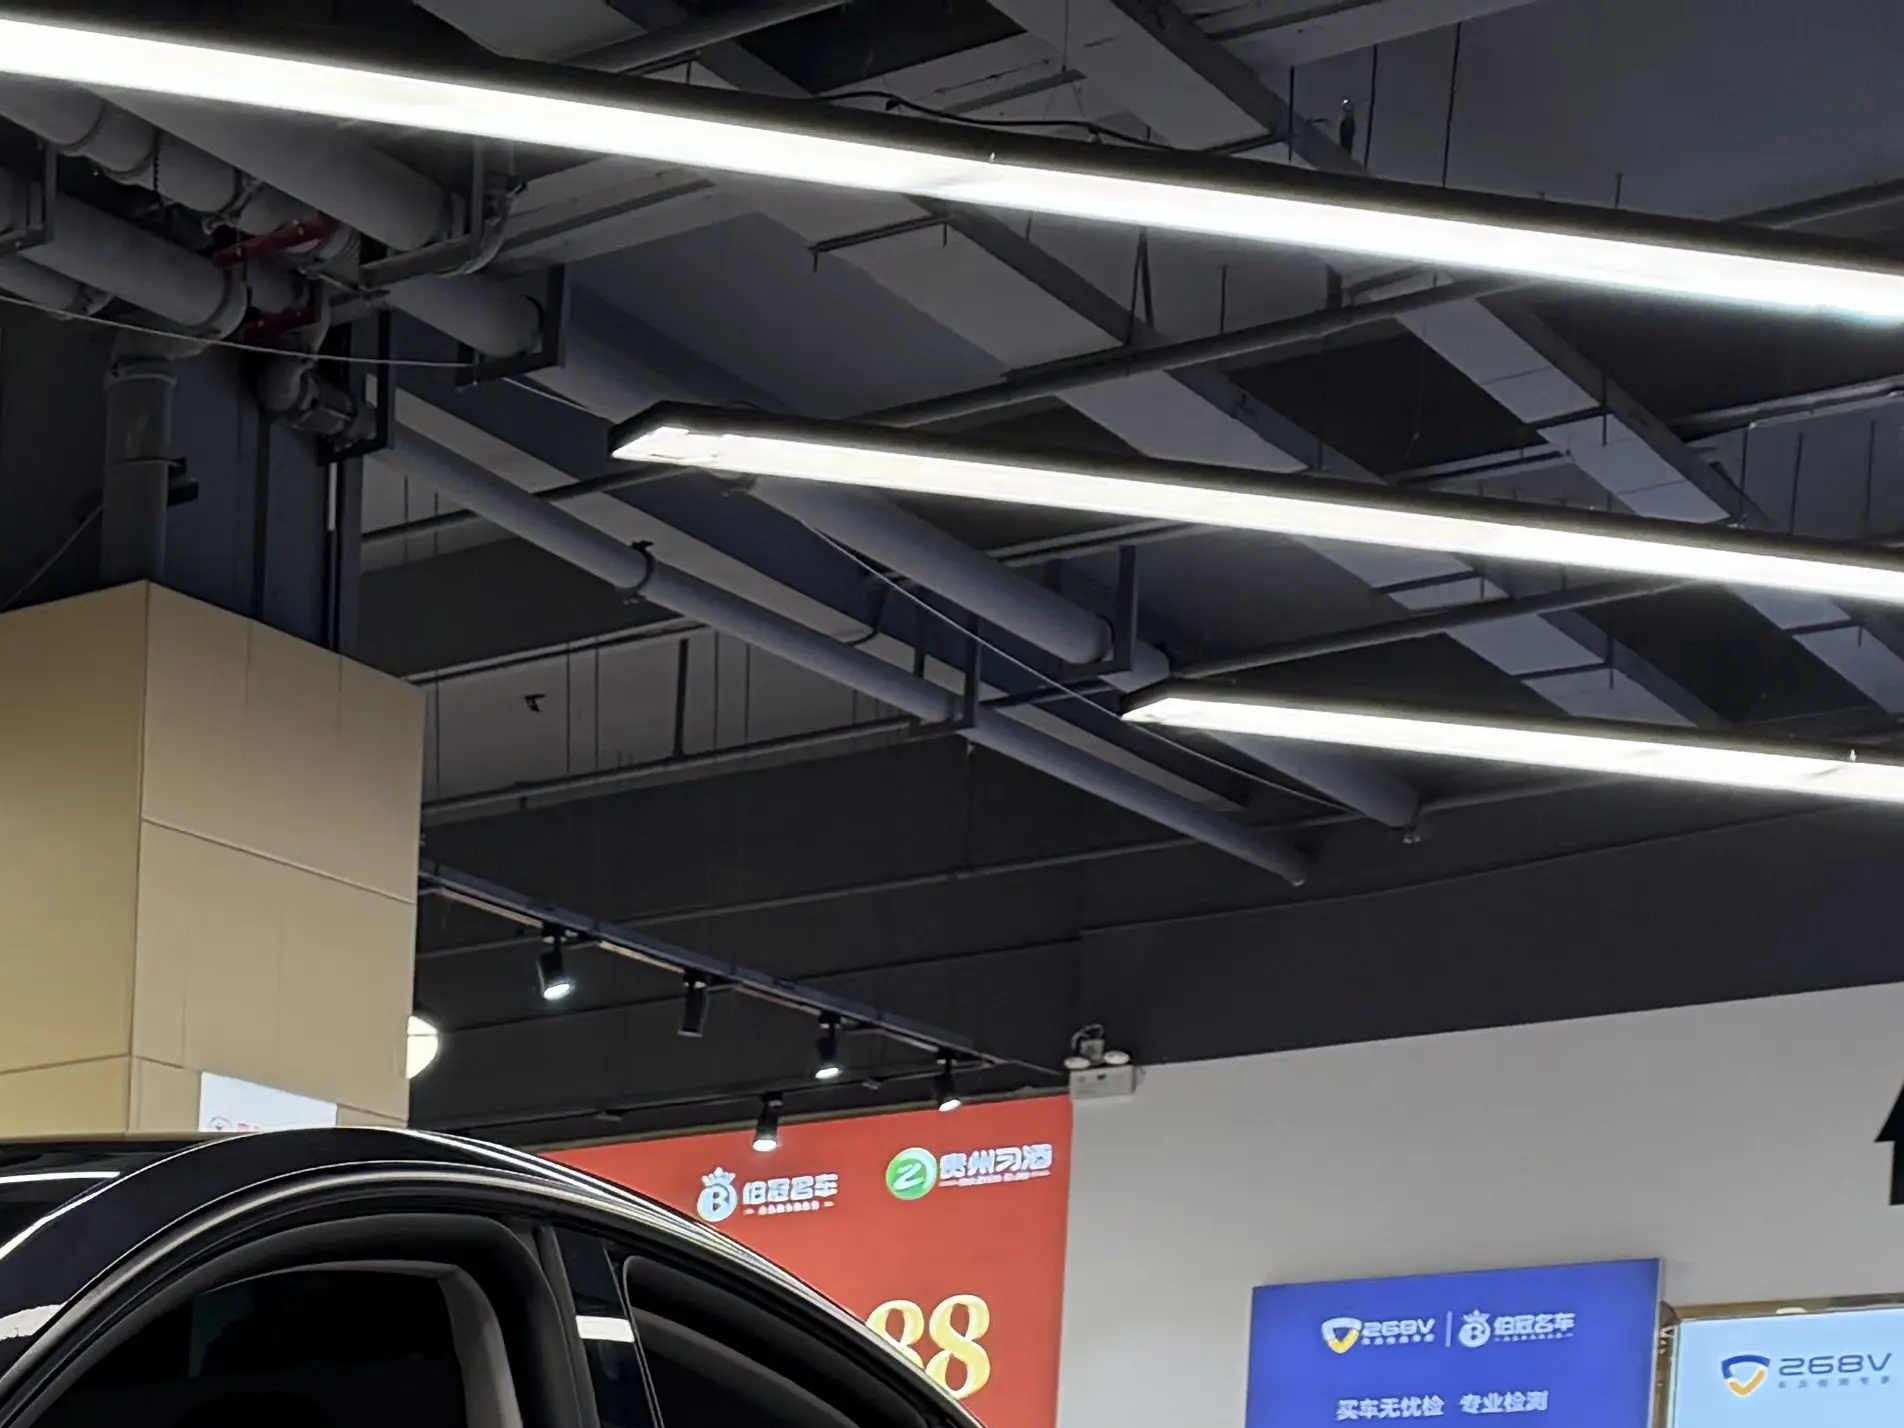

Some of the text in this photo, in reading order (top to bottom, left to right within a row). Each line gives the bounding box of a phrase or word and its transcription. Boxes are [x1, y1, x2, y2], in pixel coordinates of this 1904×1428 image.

[1362, 1318, 1436, 1338] 268V
[1778, 1352, 1892, 1377] 268V
[1336, 1390, 1549, 1421] 买车无忧检 专业检测
